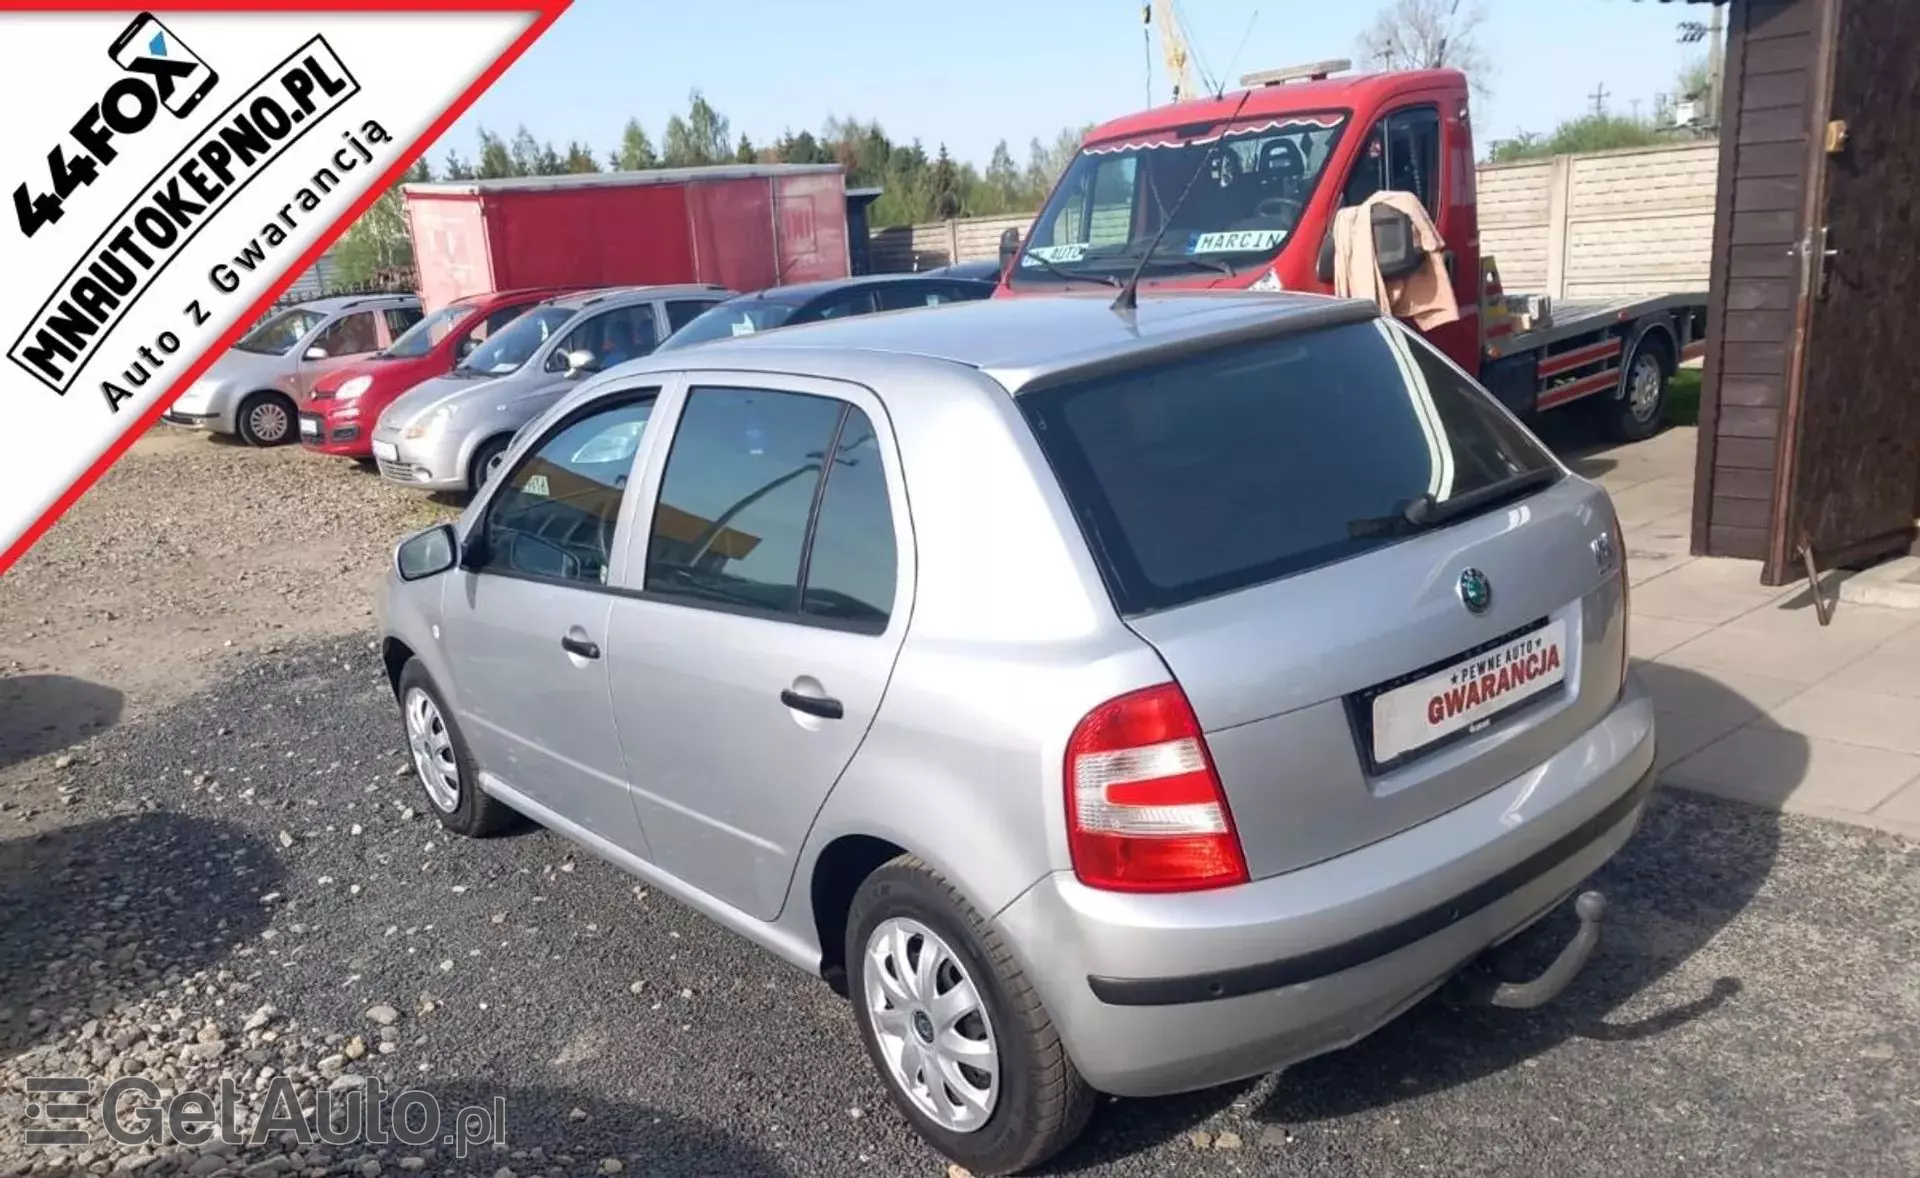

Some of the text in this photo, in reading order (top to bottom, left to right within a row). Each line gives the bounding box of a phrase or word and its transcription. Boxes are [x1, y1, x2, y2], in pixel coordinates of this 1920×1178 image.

[1202, 232, 1280, 249] MARCIN
[1462, 641, 1533, 681] PEWNE AUTO
[1428, 644, 1559, 724] GWARANCJA
